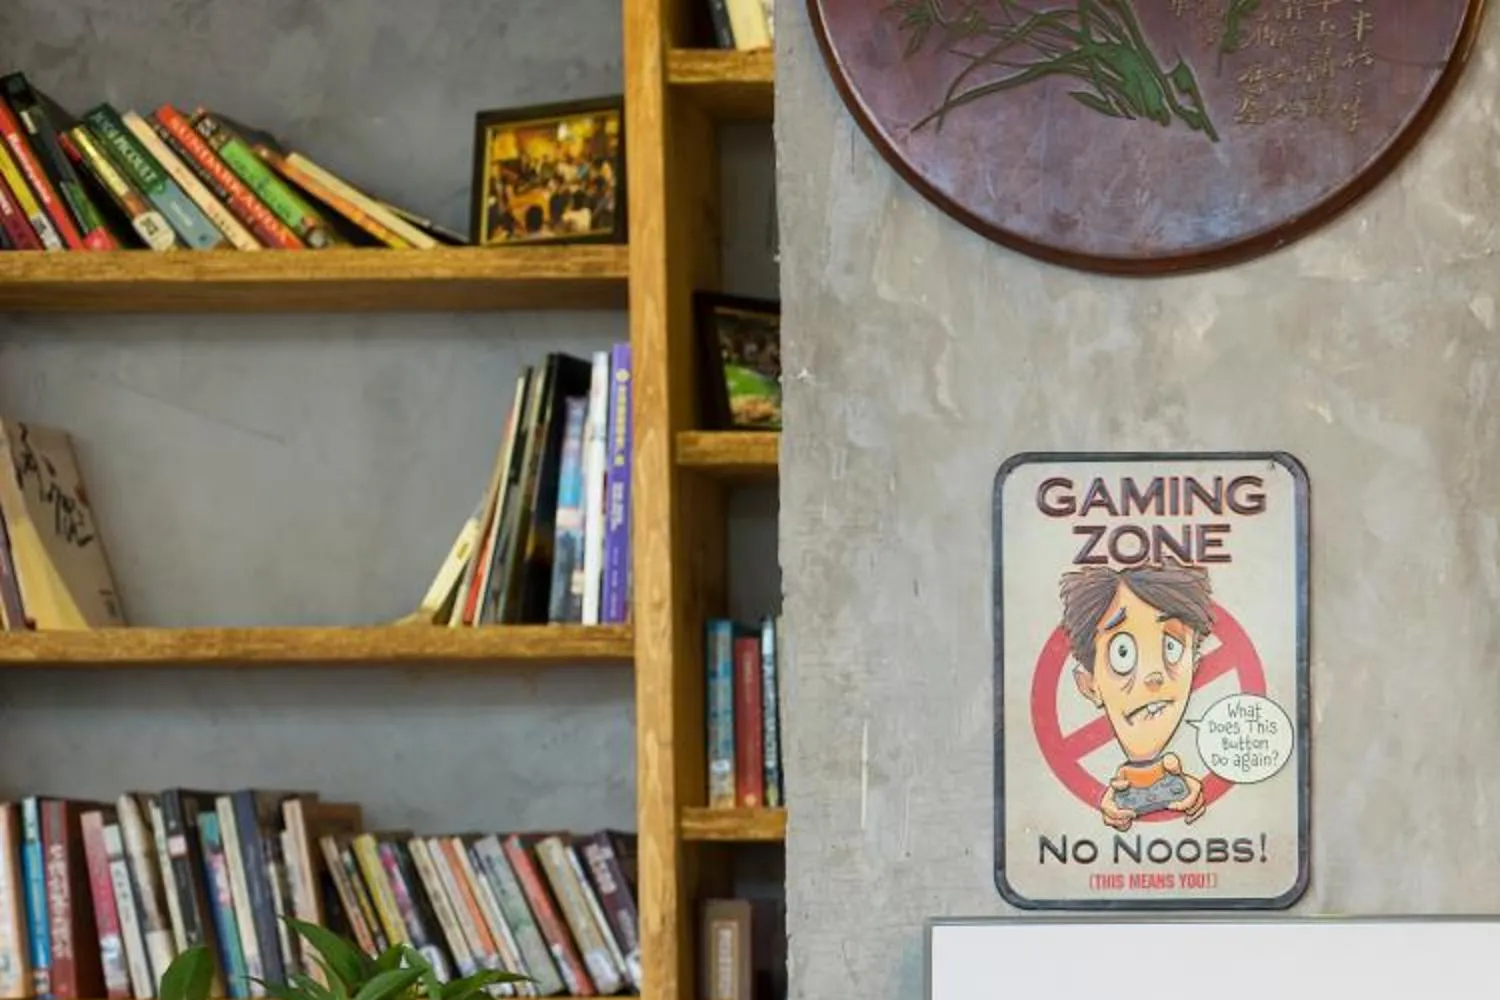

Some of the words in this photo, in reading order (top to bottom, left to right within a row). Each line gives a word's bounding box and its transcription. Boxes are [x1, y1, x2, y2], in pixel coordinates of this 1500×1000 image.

[1036, 474, 1267, 518] GAMING
[1072, 523, 1232, 565] ZONE
[1227, 700, 1263, 720] What
[1208, 720, 1241, 735] Does
[1243, 718, 1278, 736] This
[1211, 753, 1229, 767] Do
[1232, 750, 1279, 774] again?
[1129, 873, 1174, 889] MEANS
